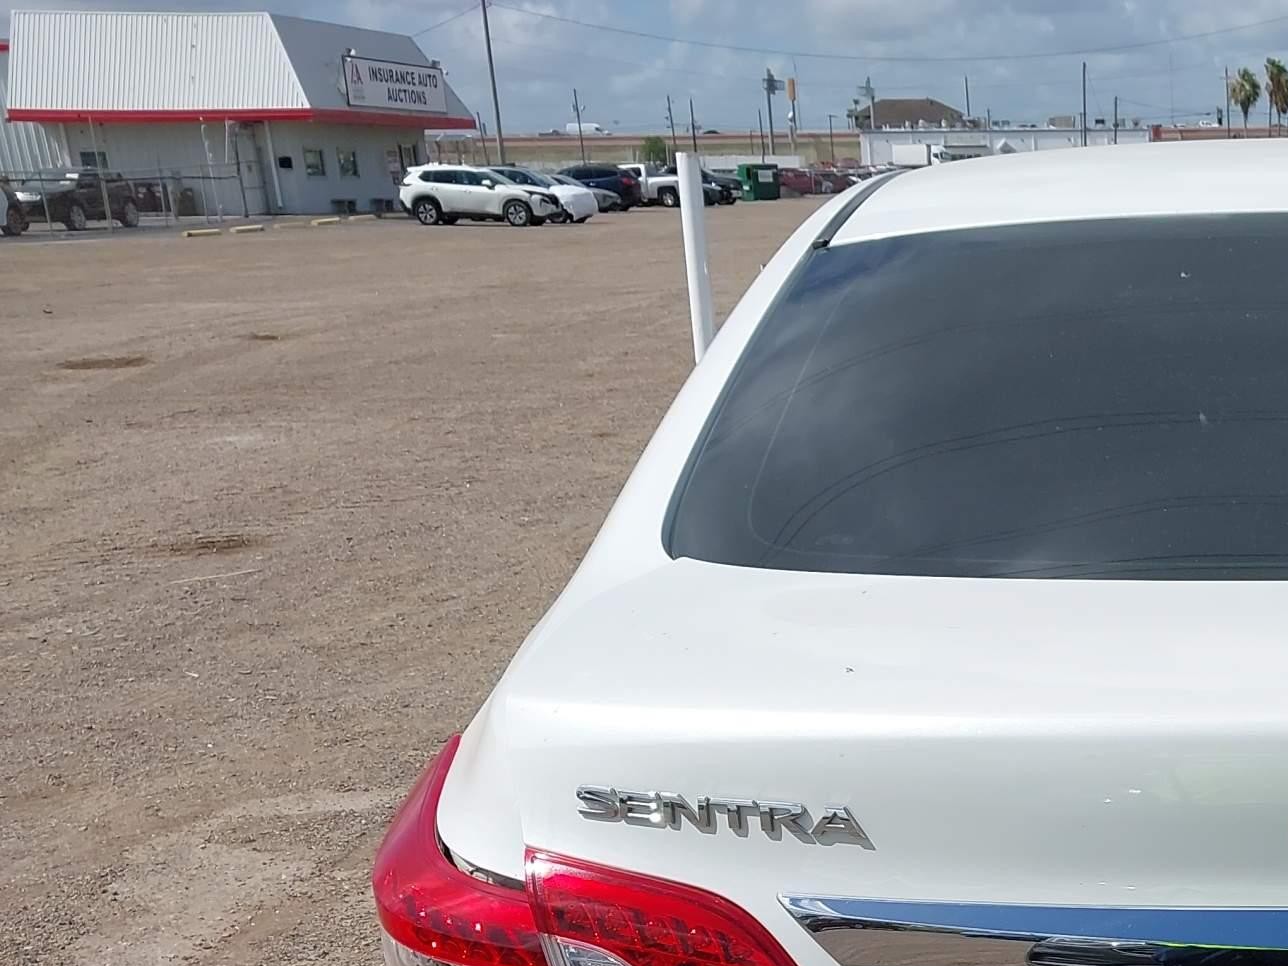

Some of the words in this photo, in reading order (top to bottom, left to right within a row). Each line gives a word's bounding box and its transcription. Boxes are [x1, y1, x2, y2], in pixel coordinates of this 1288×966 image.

[368, 66, 416, 86] INSURANCE
[418, 73, 438, 88] AUTO
[387, 87, 427, 105] AUCTIONS
[575, 783, 877, 851] SENTRA
